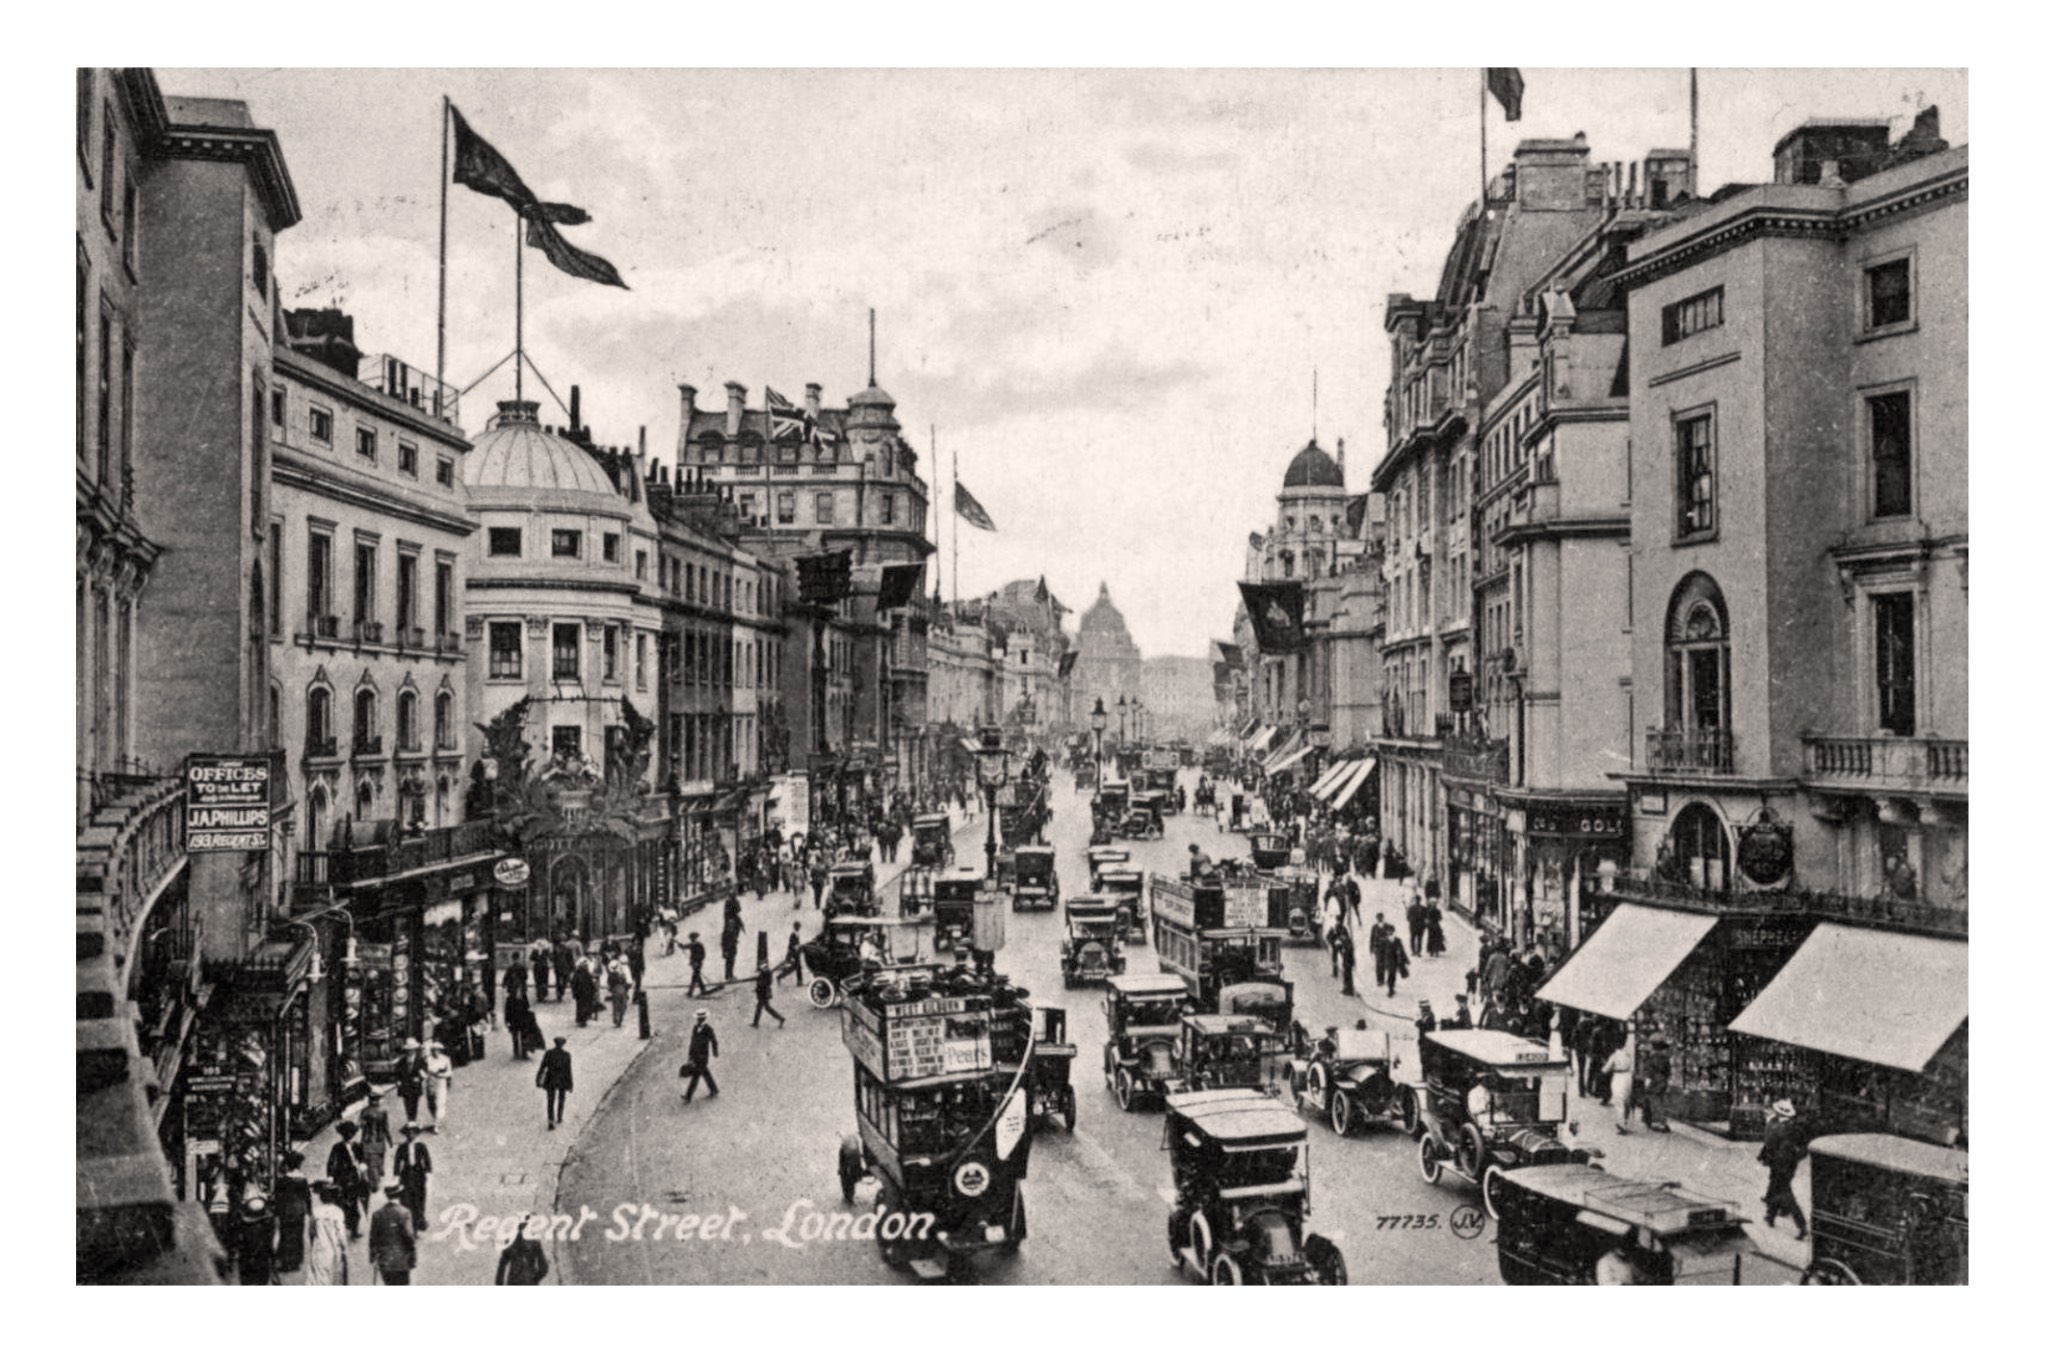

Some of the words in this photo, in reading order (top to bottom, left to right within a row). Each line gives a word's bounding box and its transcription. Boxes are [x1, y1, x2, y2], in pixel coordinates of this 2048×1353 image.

[190, 766, 268, 782] OFFICES
[195, 783, 216, 793] TO
[231, 782, 261, 793] LET
